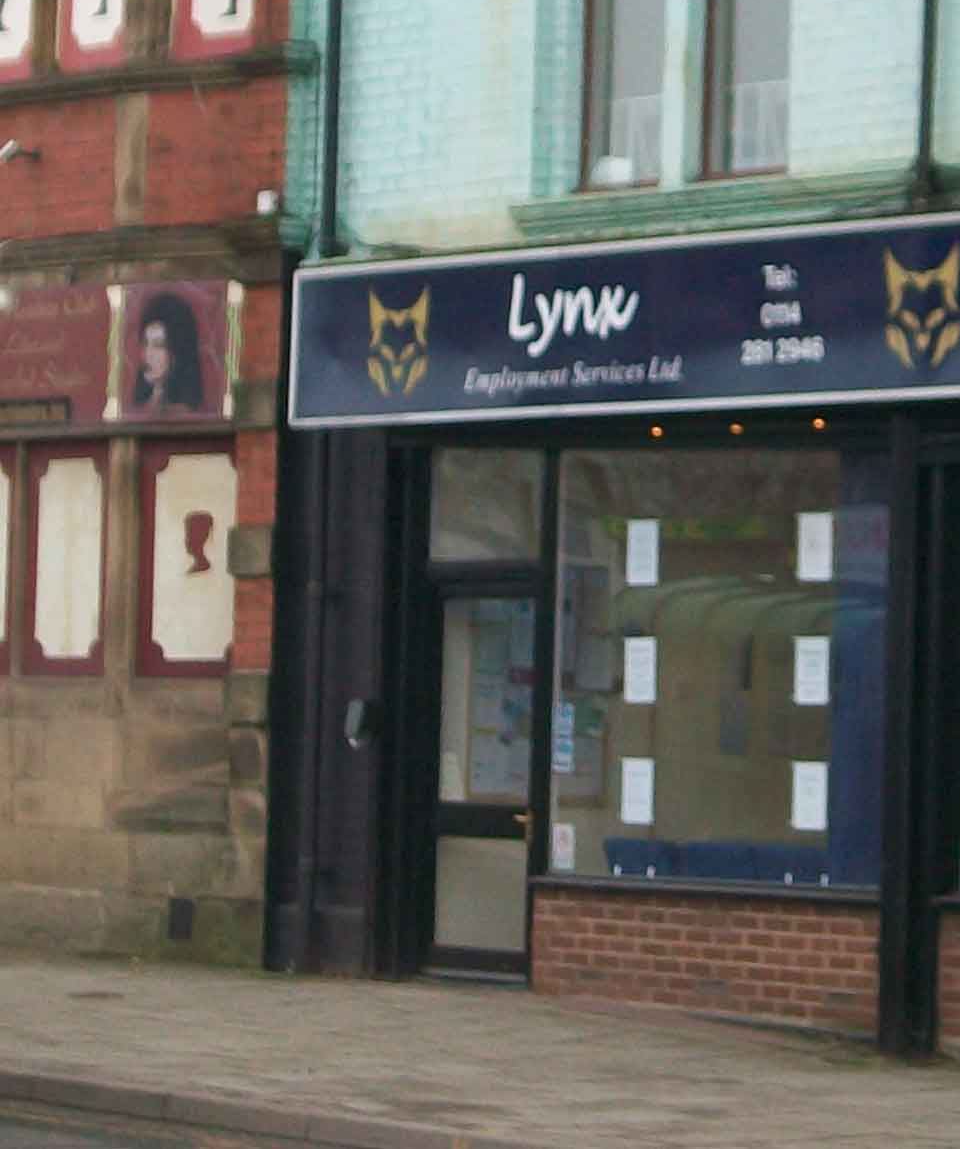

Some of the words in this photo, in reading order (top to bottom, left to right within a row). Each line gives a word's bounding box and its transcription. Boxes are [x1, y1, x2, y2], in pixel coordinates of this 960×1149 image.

[508, 272, 639, 357] Lynx
[464, 365, 570, 397] Employment
[572, 359, 646, 387] Services
